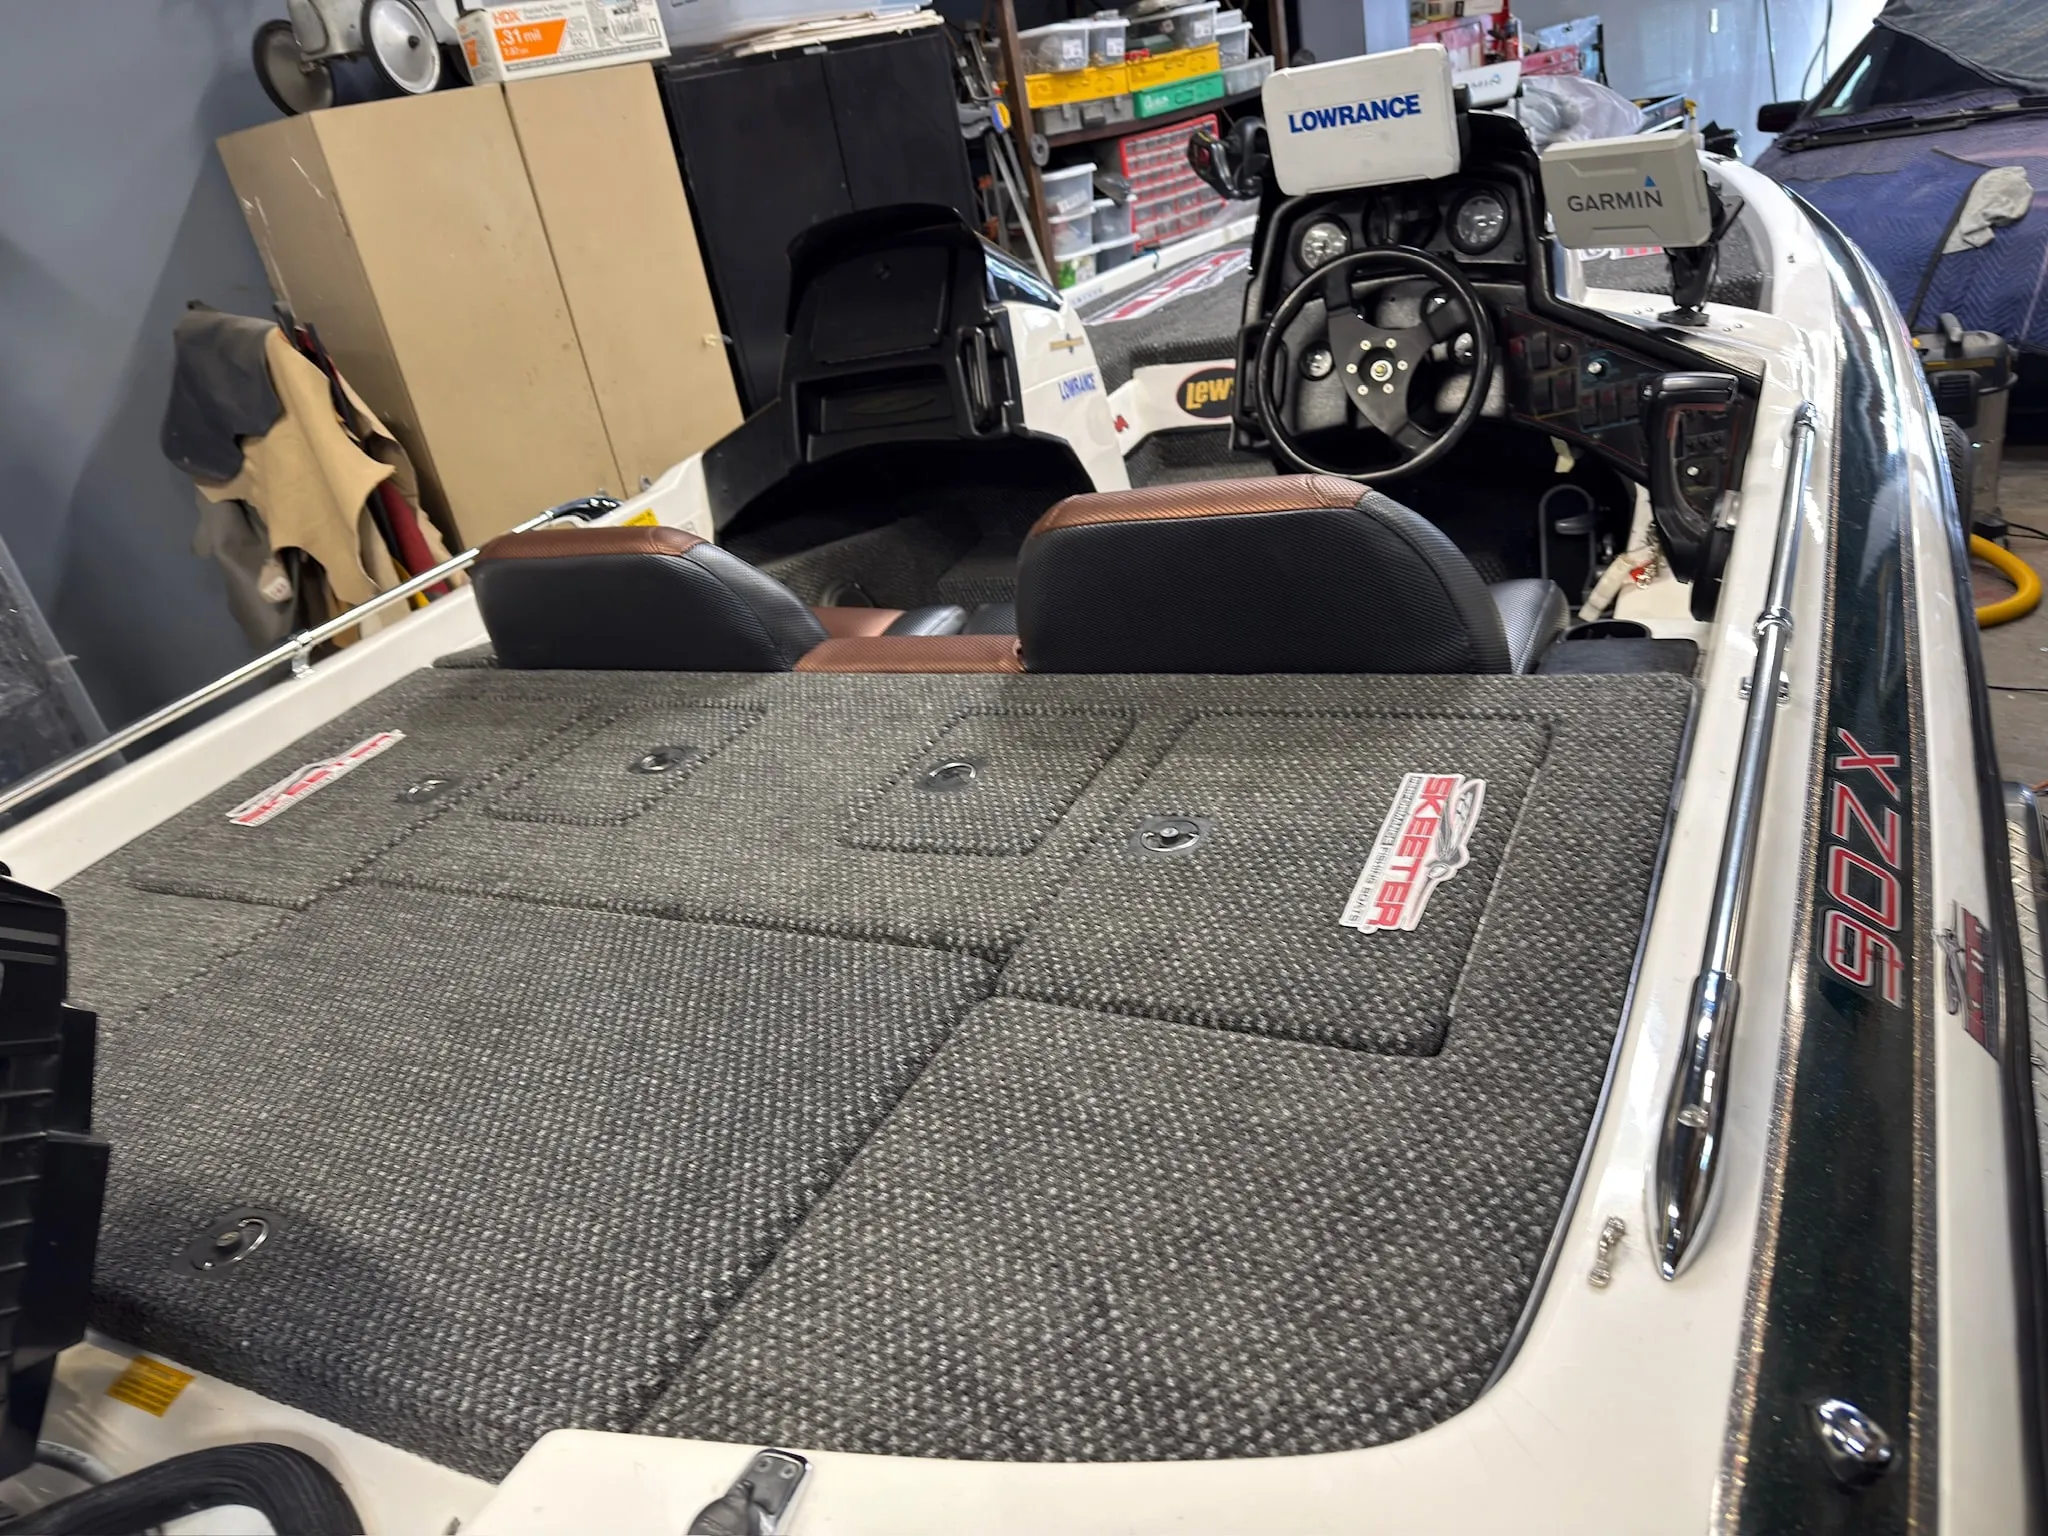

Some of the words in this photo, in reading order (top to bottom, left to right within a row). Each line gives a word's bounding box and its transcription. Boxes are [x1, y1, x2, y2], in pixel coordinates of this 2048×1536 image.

[522, 27, 543, 43] mil
[1288, 93, 1422, 134] LOWRANCE
[1567, 190, 1663, 213] GARMIN
[1057, 372, 1097, 401] LOWRANCE
[1365, 777, 1455, 927] SKEETER
[1821, 727, 1905, 1009] 90ZX
